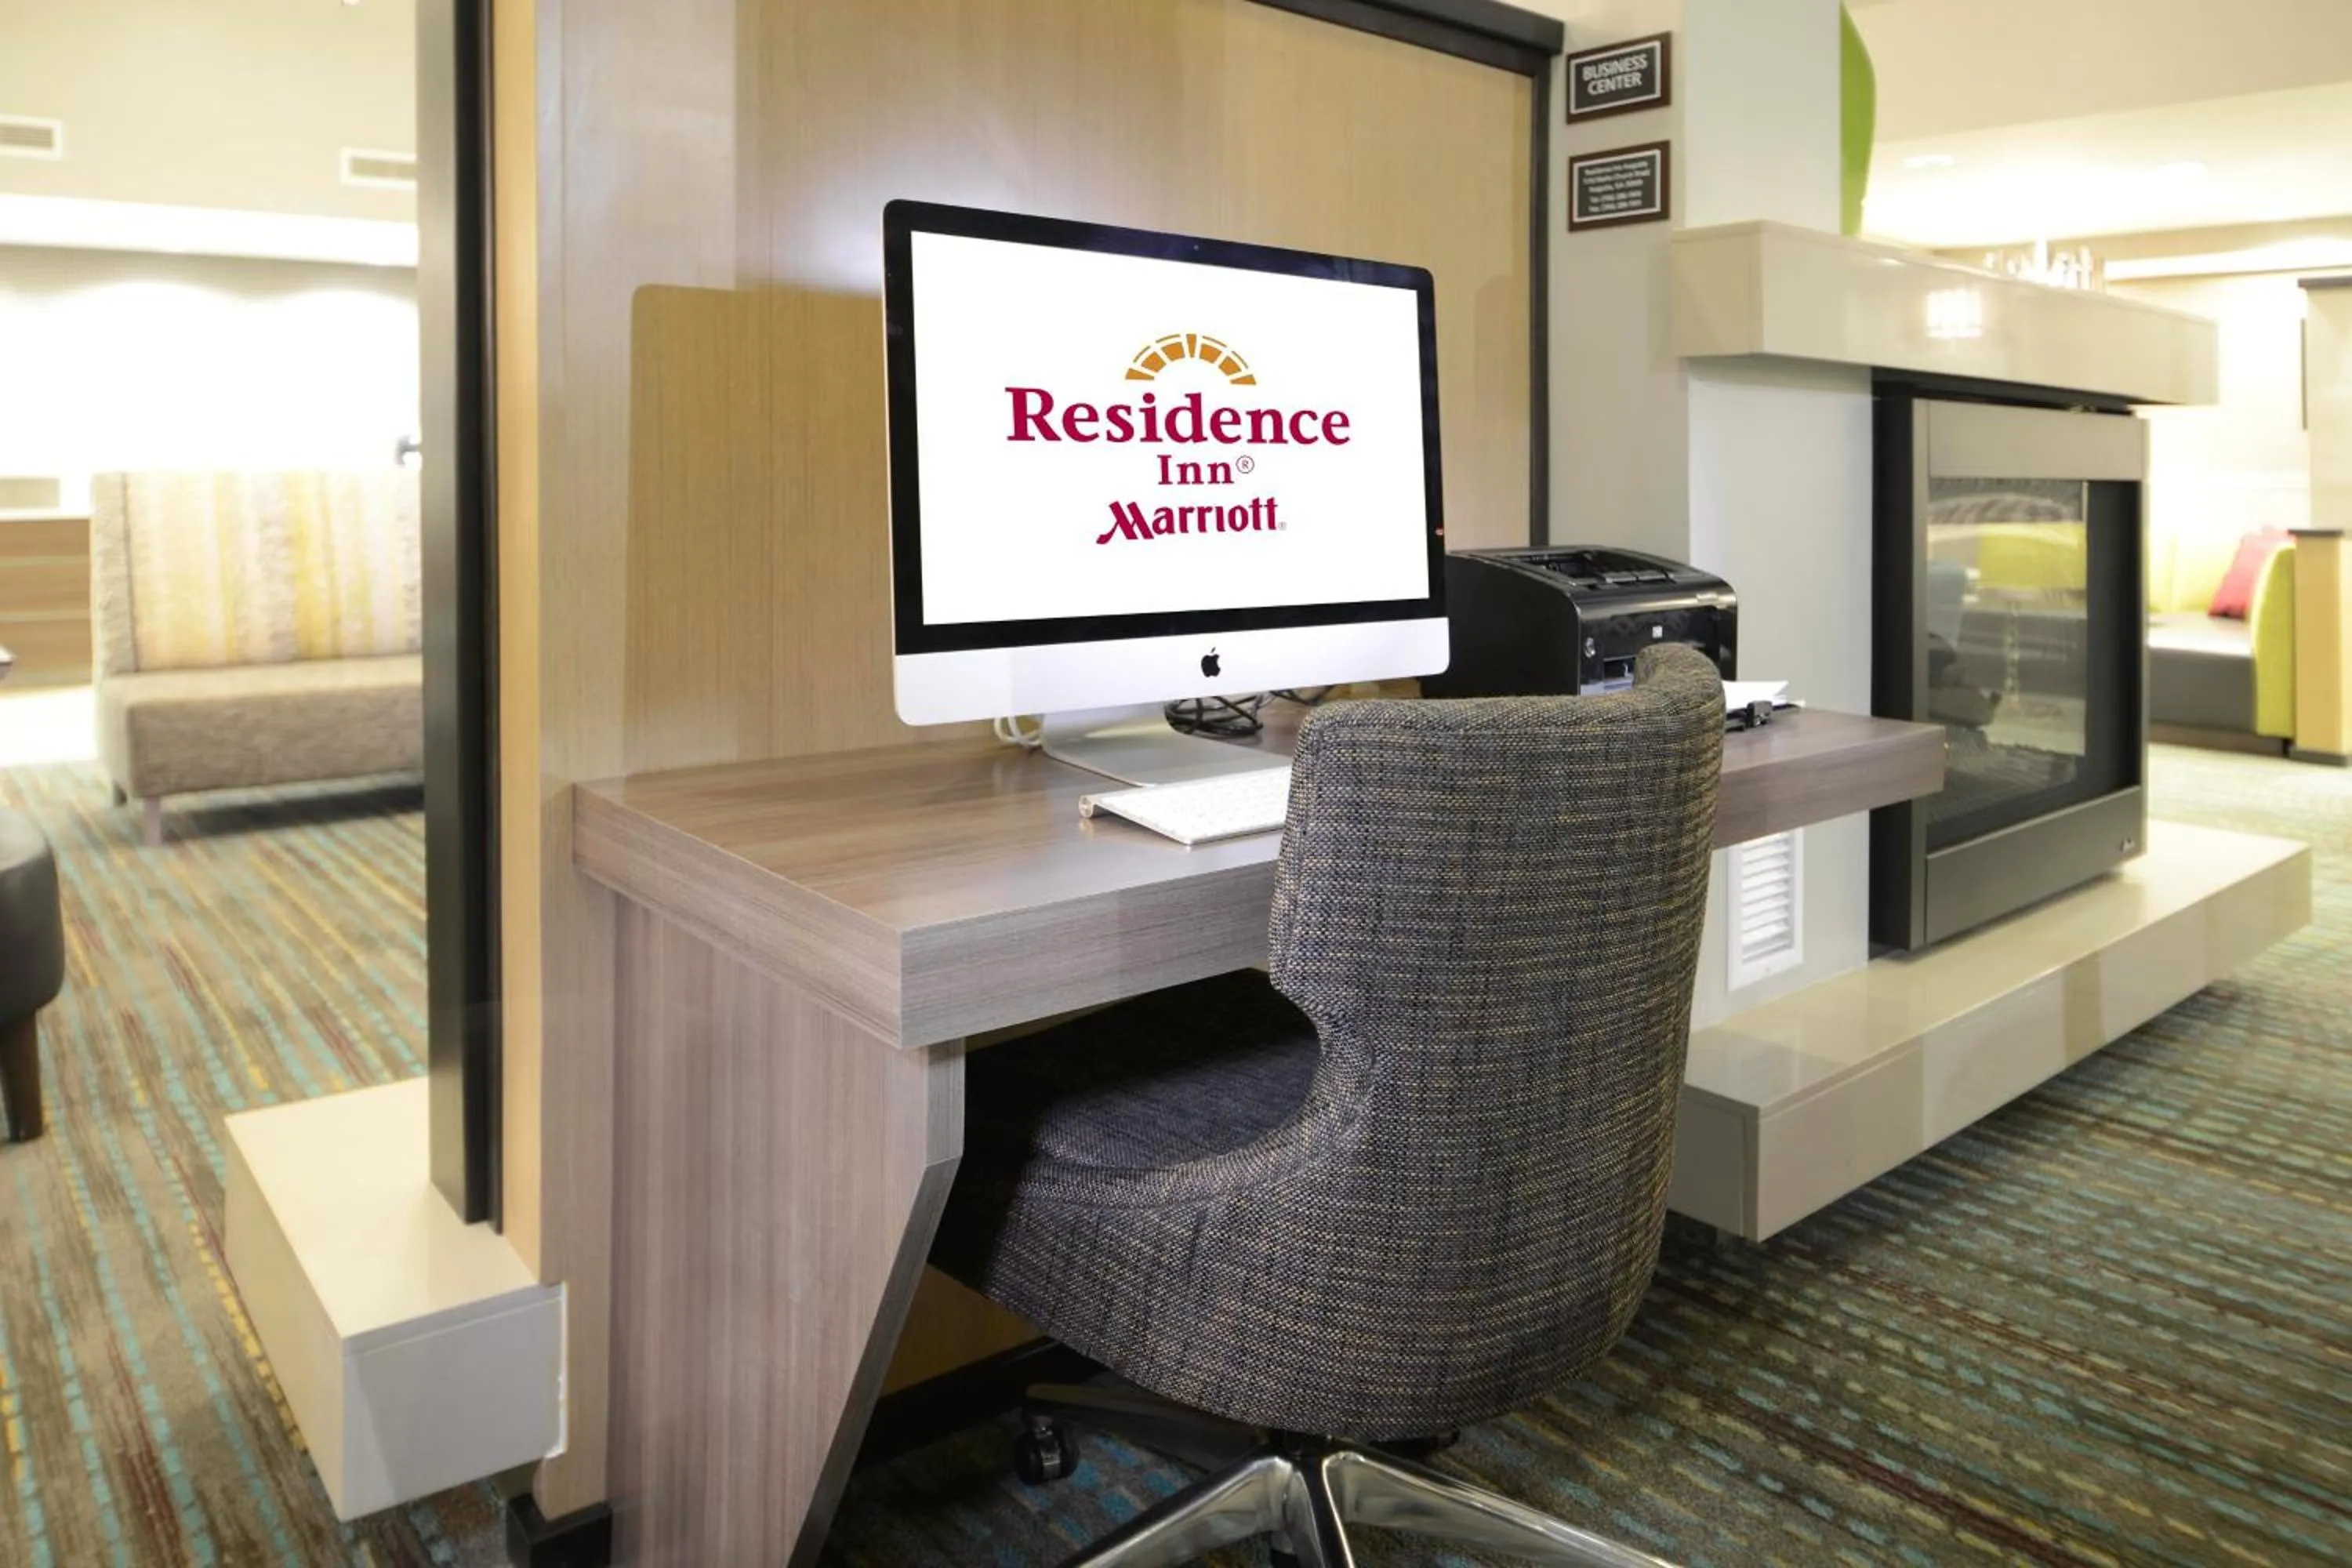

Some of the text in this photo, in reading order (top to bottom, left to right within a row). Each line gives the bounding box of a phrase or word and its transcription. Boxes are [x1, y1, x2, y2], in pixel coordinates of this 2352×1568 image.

[1582, 53, 1648, 81] BUSINESS
[1588, 72, 1642, 95] CENTER
[1005, 387, 1351, 445] Residence
[1095, 497, 1279, 545] Marriott
